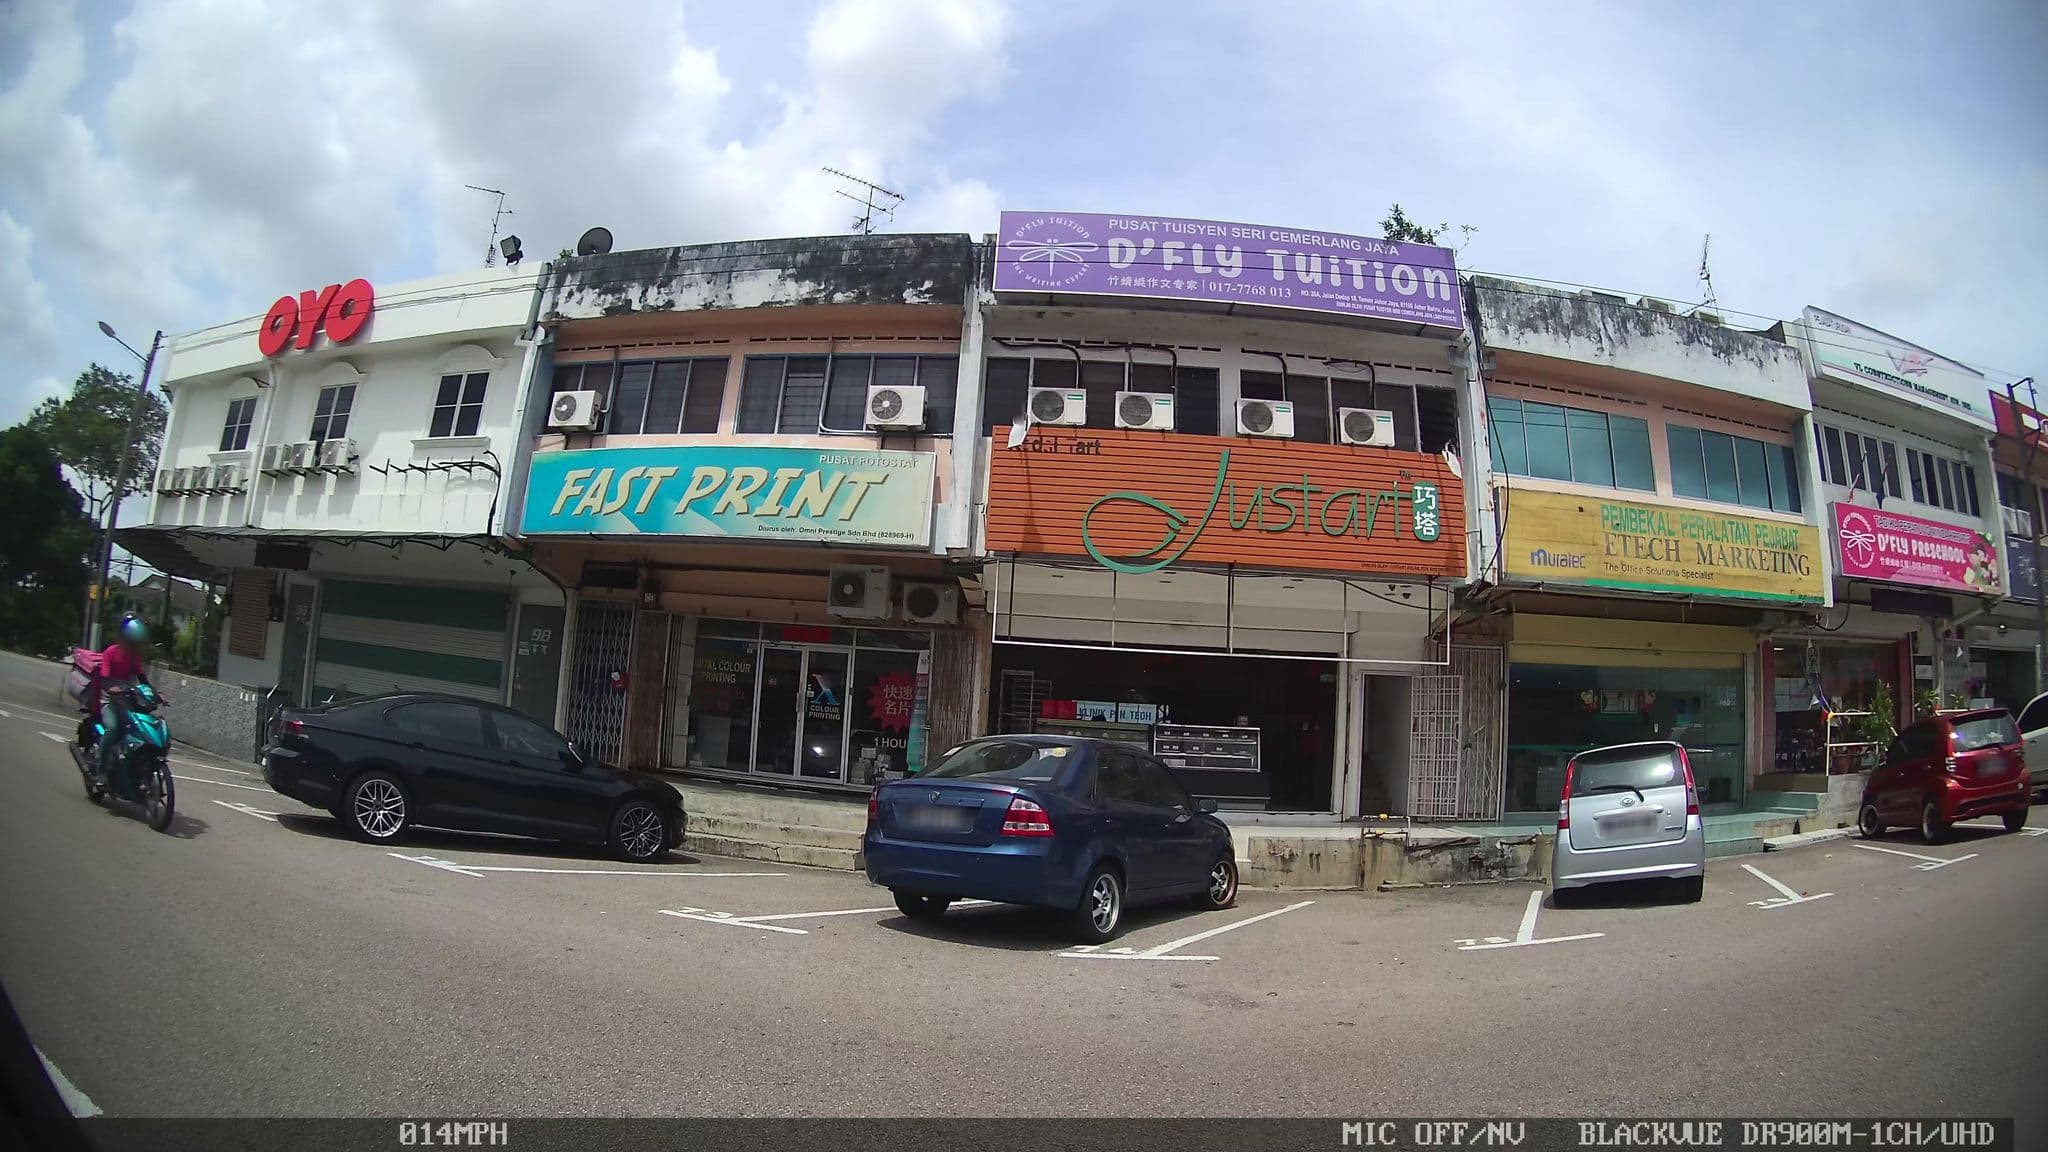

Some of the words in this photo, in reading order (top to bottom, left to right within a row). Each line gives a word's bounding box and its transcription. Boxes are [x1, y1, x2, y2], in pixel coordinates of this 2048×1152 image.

[1108, 219, 1158, 232] PUSAT
[1162, 221, 1227, 237] TUISYEN
[1231, 227, 1265, 240] SERI
[1269, 230, 1361, 251] CEMERLANG
[1365, 242, 1400, 256] JAYA
[1209, 281, 1266, 296] 017-7768
[1270, 285, 1292, 298] 013
[258, 279, 374, 357] OYO
[820, 454, 857, 466] PUSAT
[859, 456, 919, 468] FOTOSTAT
[550, 466, 678, 517] FAST
[674, 466, 890, 522] PRINT
[1413, 485, 1438, 536] 巧塔
[799, 526, 817, 534] Omni
[818, 527, 846, 537] Prestige
[847, 529, 861, 537] Sdn
[863, 530, 876, 538] Bhd
[1600, 504, 1676, 537] PEMBEKAL
[1680, 513, 1750, 545] PERALATAN
[1754, 524, 1799, 550] PEJABAT
[1603, 532, 1681, 563] ETECH
[1696, 542, 1810, 577] MARKETING
[1911, 539, 1966, 564] PRESCHOOL
[1604, 562, 1619, 572] The
[1621, 563, 1643, 574] Office
[1646, 566, 1679, 577] Solutions
[1682, 569, 1714, 581] Specialist
[719, 660, 751, 673] COLOUR
[883, 684, 913, 700] 快速
[808, 711, 841, 720] PRINTING
[810, 704, 840, 713] COLOUR
[884, 700, 911, 716] 名片
[874, 737, 879, 747] 1
[882, 737, 907, 749] HOU
